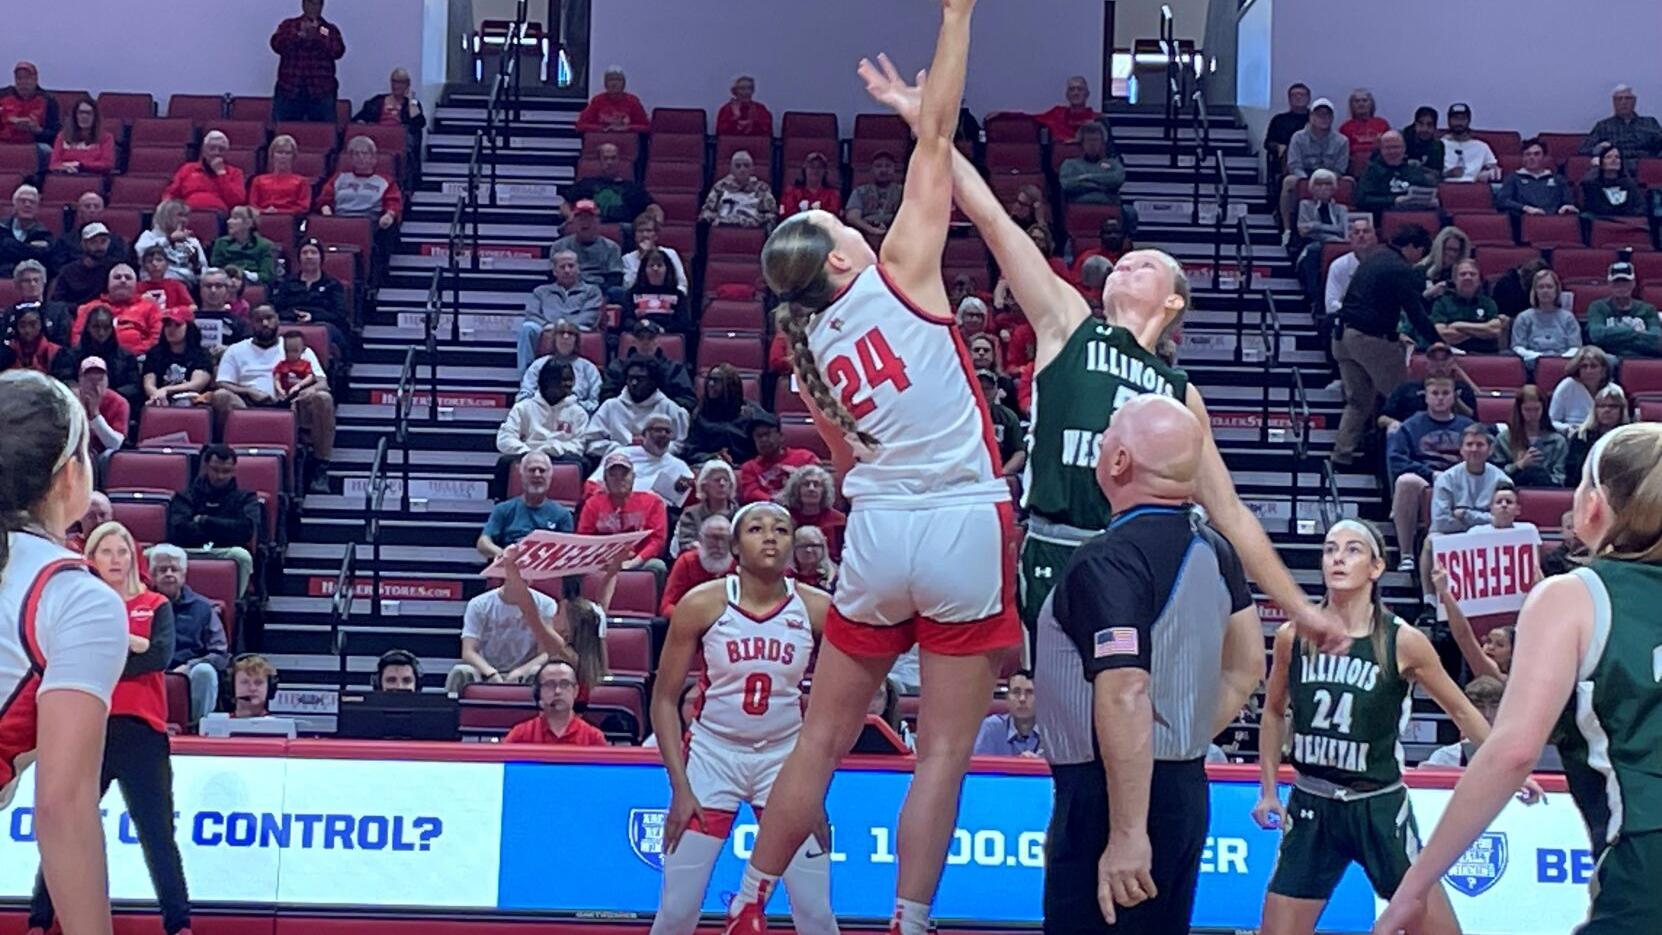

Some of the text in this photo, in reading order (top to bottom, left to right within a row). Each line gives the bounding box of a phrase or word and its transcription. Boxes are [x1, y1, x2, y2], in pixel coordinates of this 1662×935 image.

[827, 327, 912, 421] 24
[726, 637, 795, 665] BIRDS
[1300, 653, 1380, 691] ILLINOIS
[742, 672, 772, 716] 0
[1311, 689, 1354, 734] 24
[1294, 733, 1370, 773] WESLEYAN
[192, 811, 442, 851] CONTROL?
